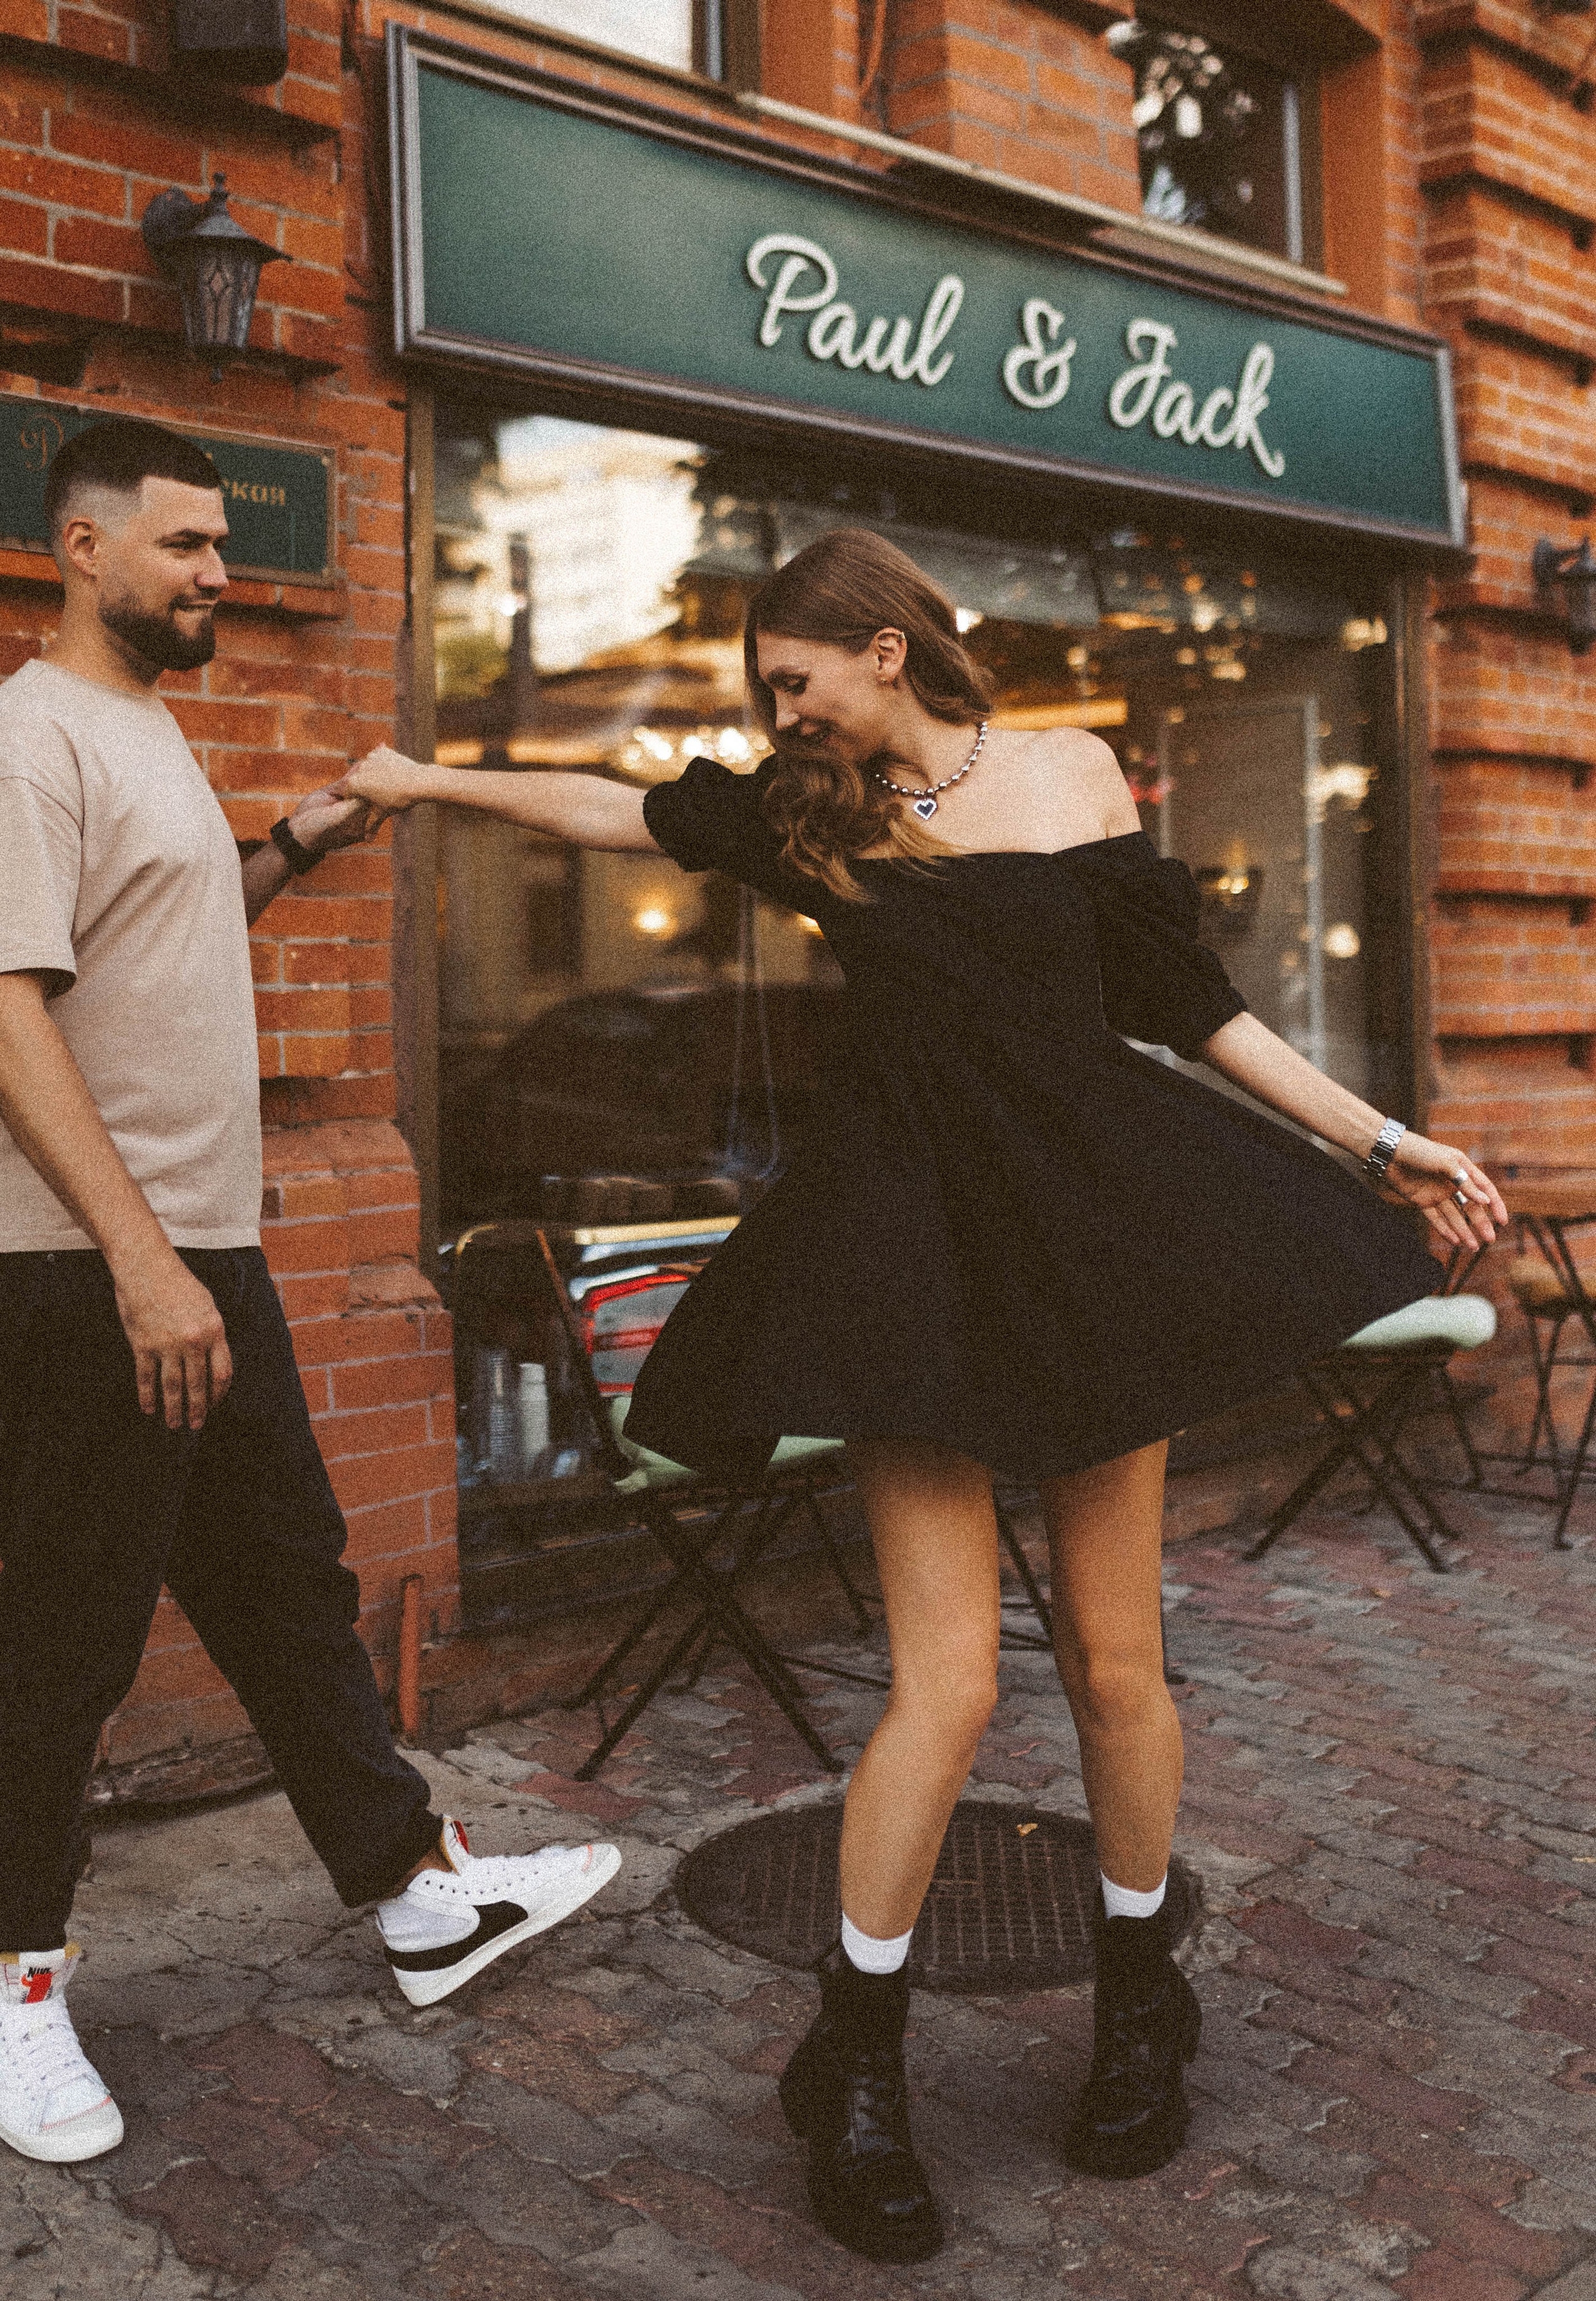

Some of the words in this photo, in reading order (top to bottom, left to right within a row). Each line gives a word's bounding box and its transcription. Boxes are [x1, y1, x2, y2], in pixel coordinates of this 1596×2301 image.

[747, 233, 964, 387] Paul
[1002, 298, 1077, 409] &
[1108, 317, 1286, 479] Jack
